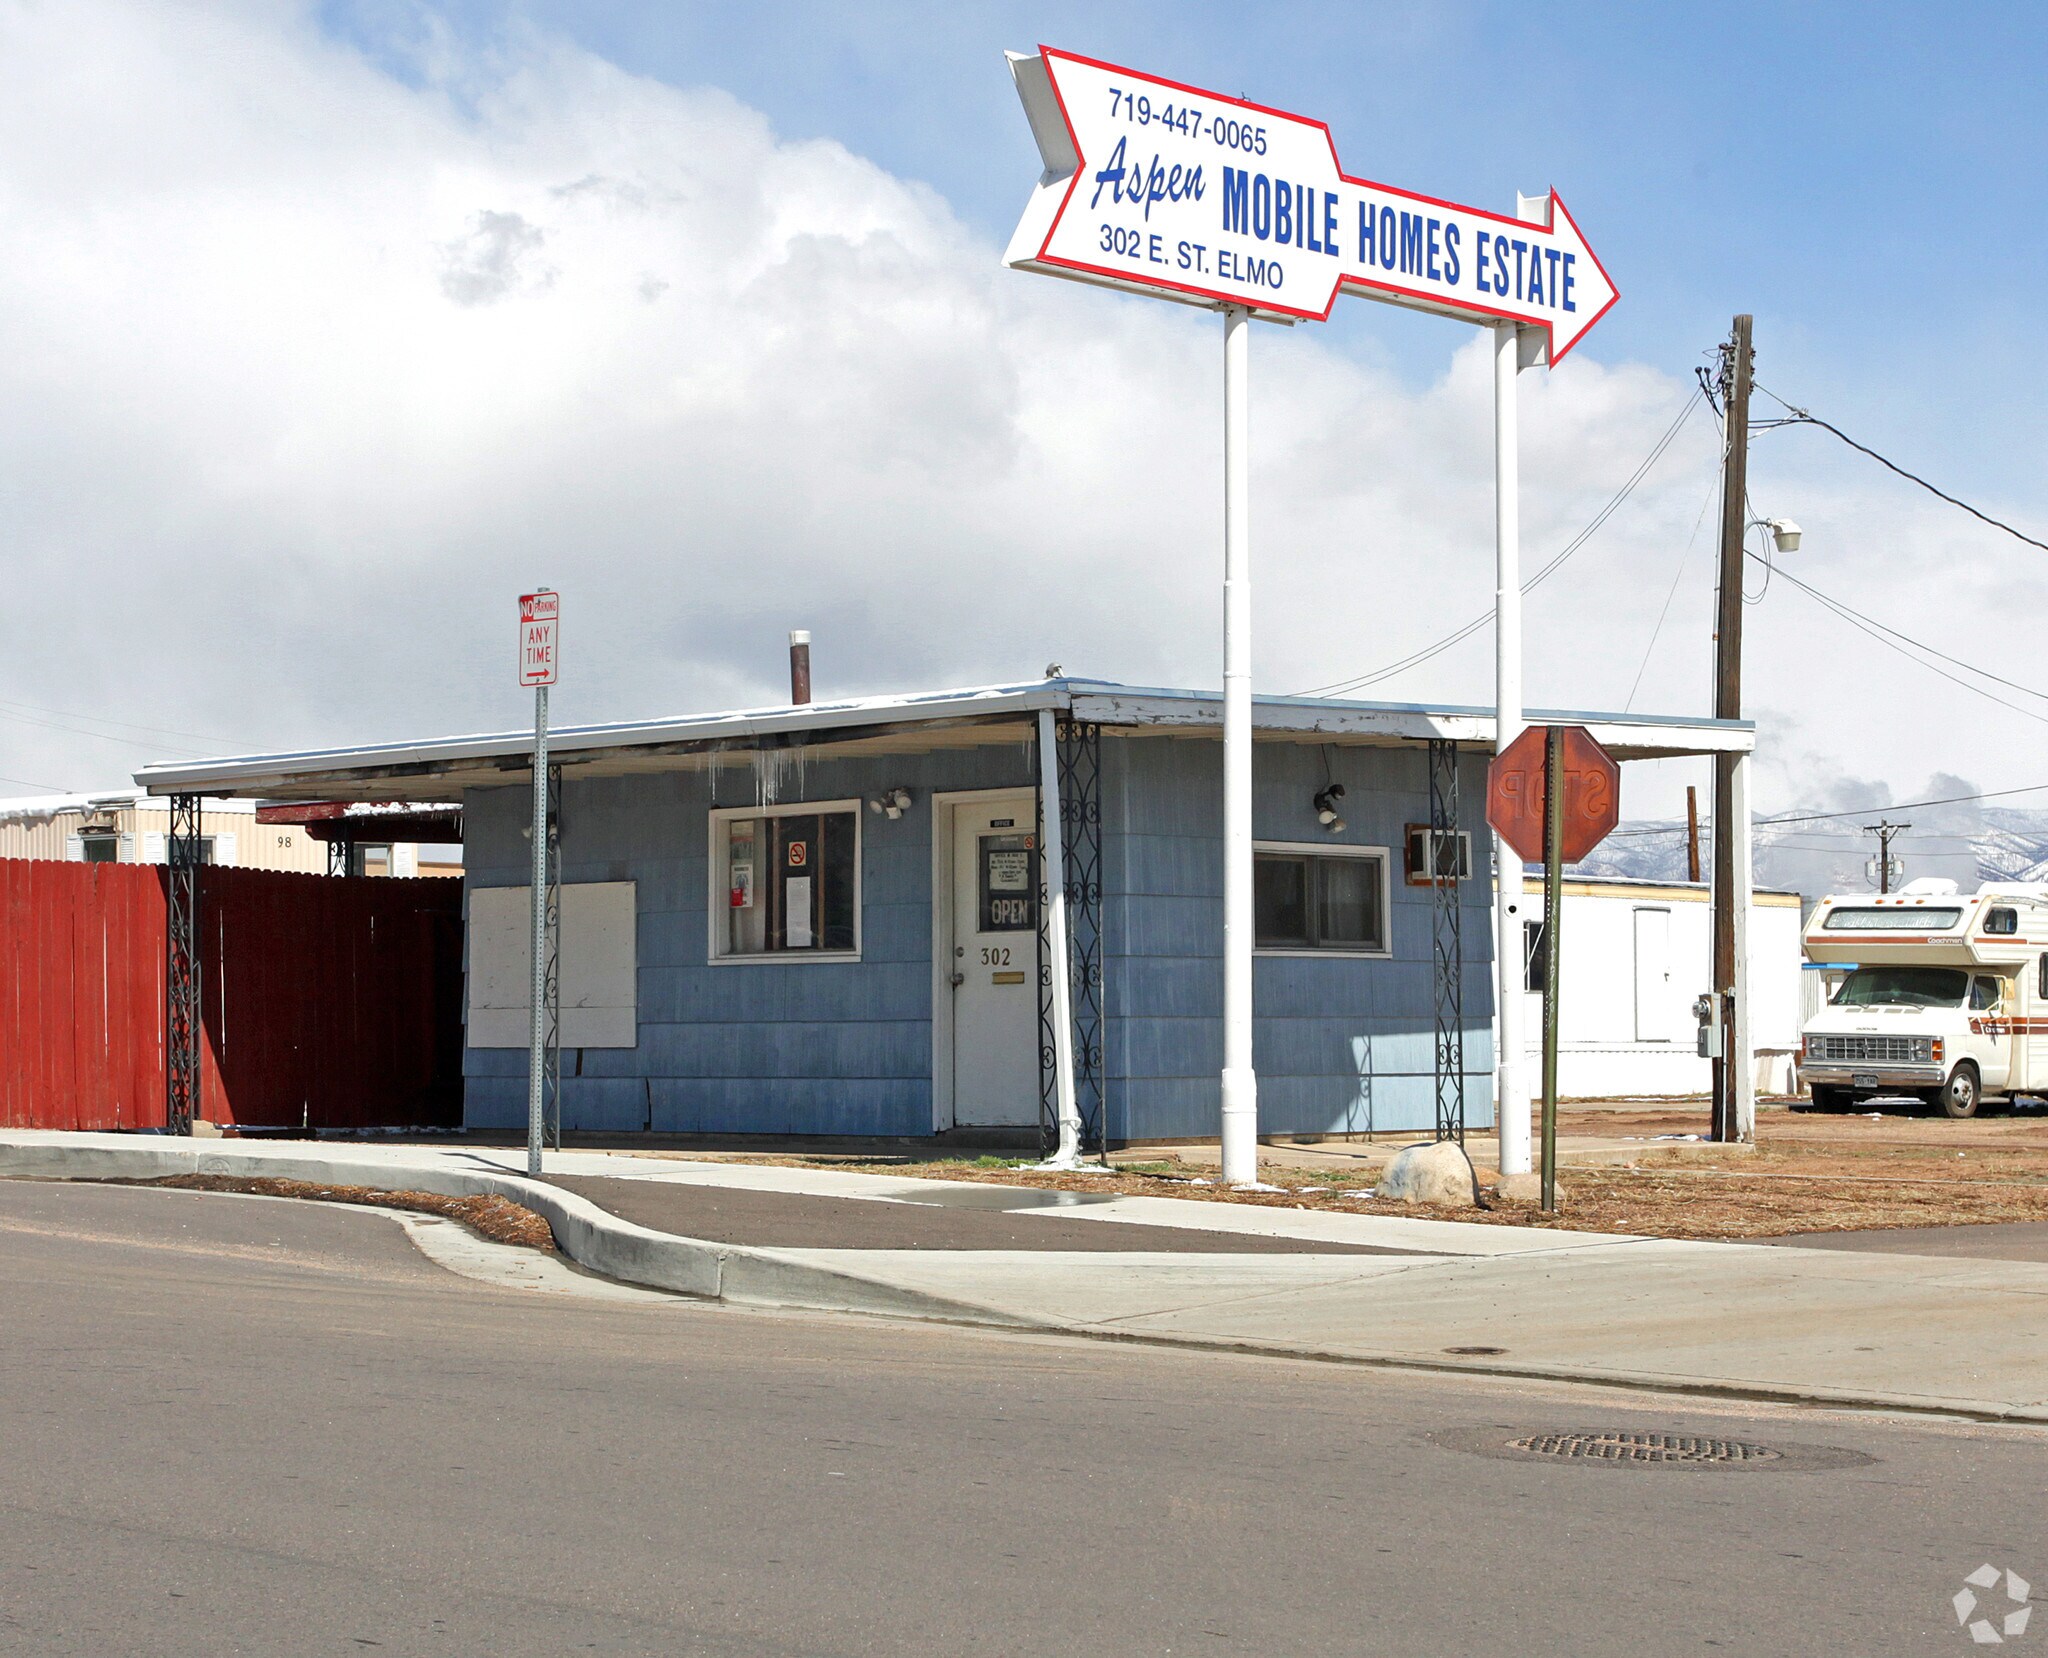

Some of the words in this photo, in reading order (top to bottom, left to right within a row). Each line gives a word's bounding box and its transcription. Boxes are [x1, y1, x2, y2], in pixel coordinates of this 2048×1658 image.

[1109, 87, 1267, 156] 719-447-0065
[1091, 135, 1206, 222] Aspen
[1223, 165, 1339, 257] MOBILE
[1359, 200, 1461, 286] HOMES
[1476, 230, 1576, 314] ESTATE
[1100, 223, 1141, 258] 302
[1149, 234, 1170, 264] E.
[1178, 240, 1210, 276] ST.
[1218, 249, 1283, 289] ELMO
[520, 600, 534, 617] NO
[534, 600, 556, 613] PARKING
[528, 626, 550, 644] ANY
[526, 646, 551, 664] TIME
[277, 836, 292, 848] 98
[992, 899, 1027, 924] OPEN
[981, 948, 1010, 966] 302
